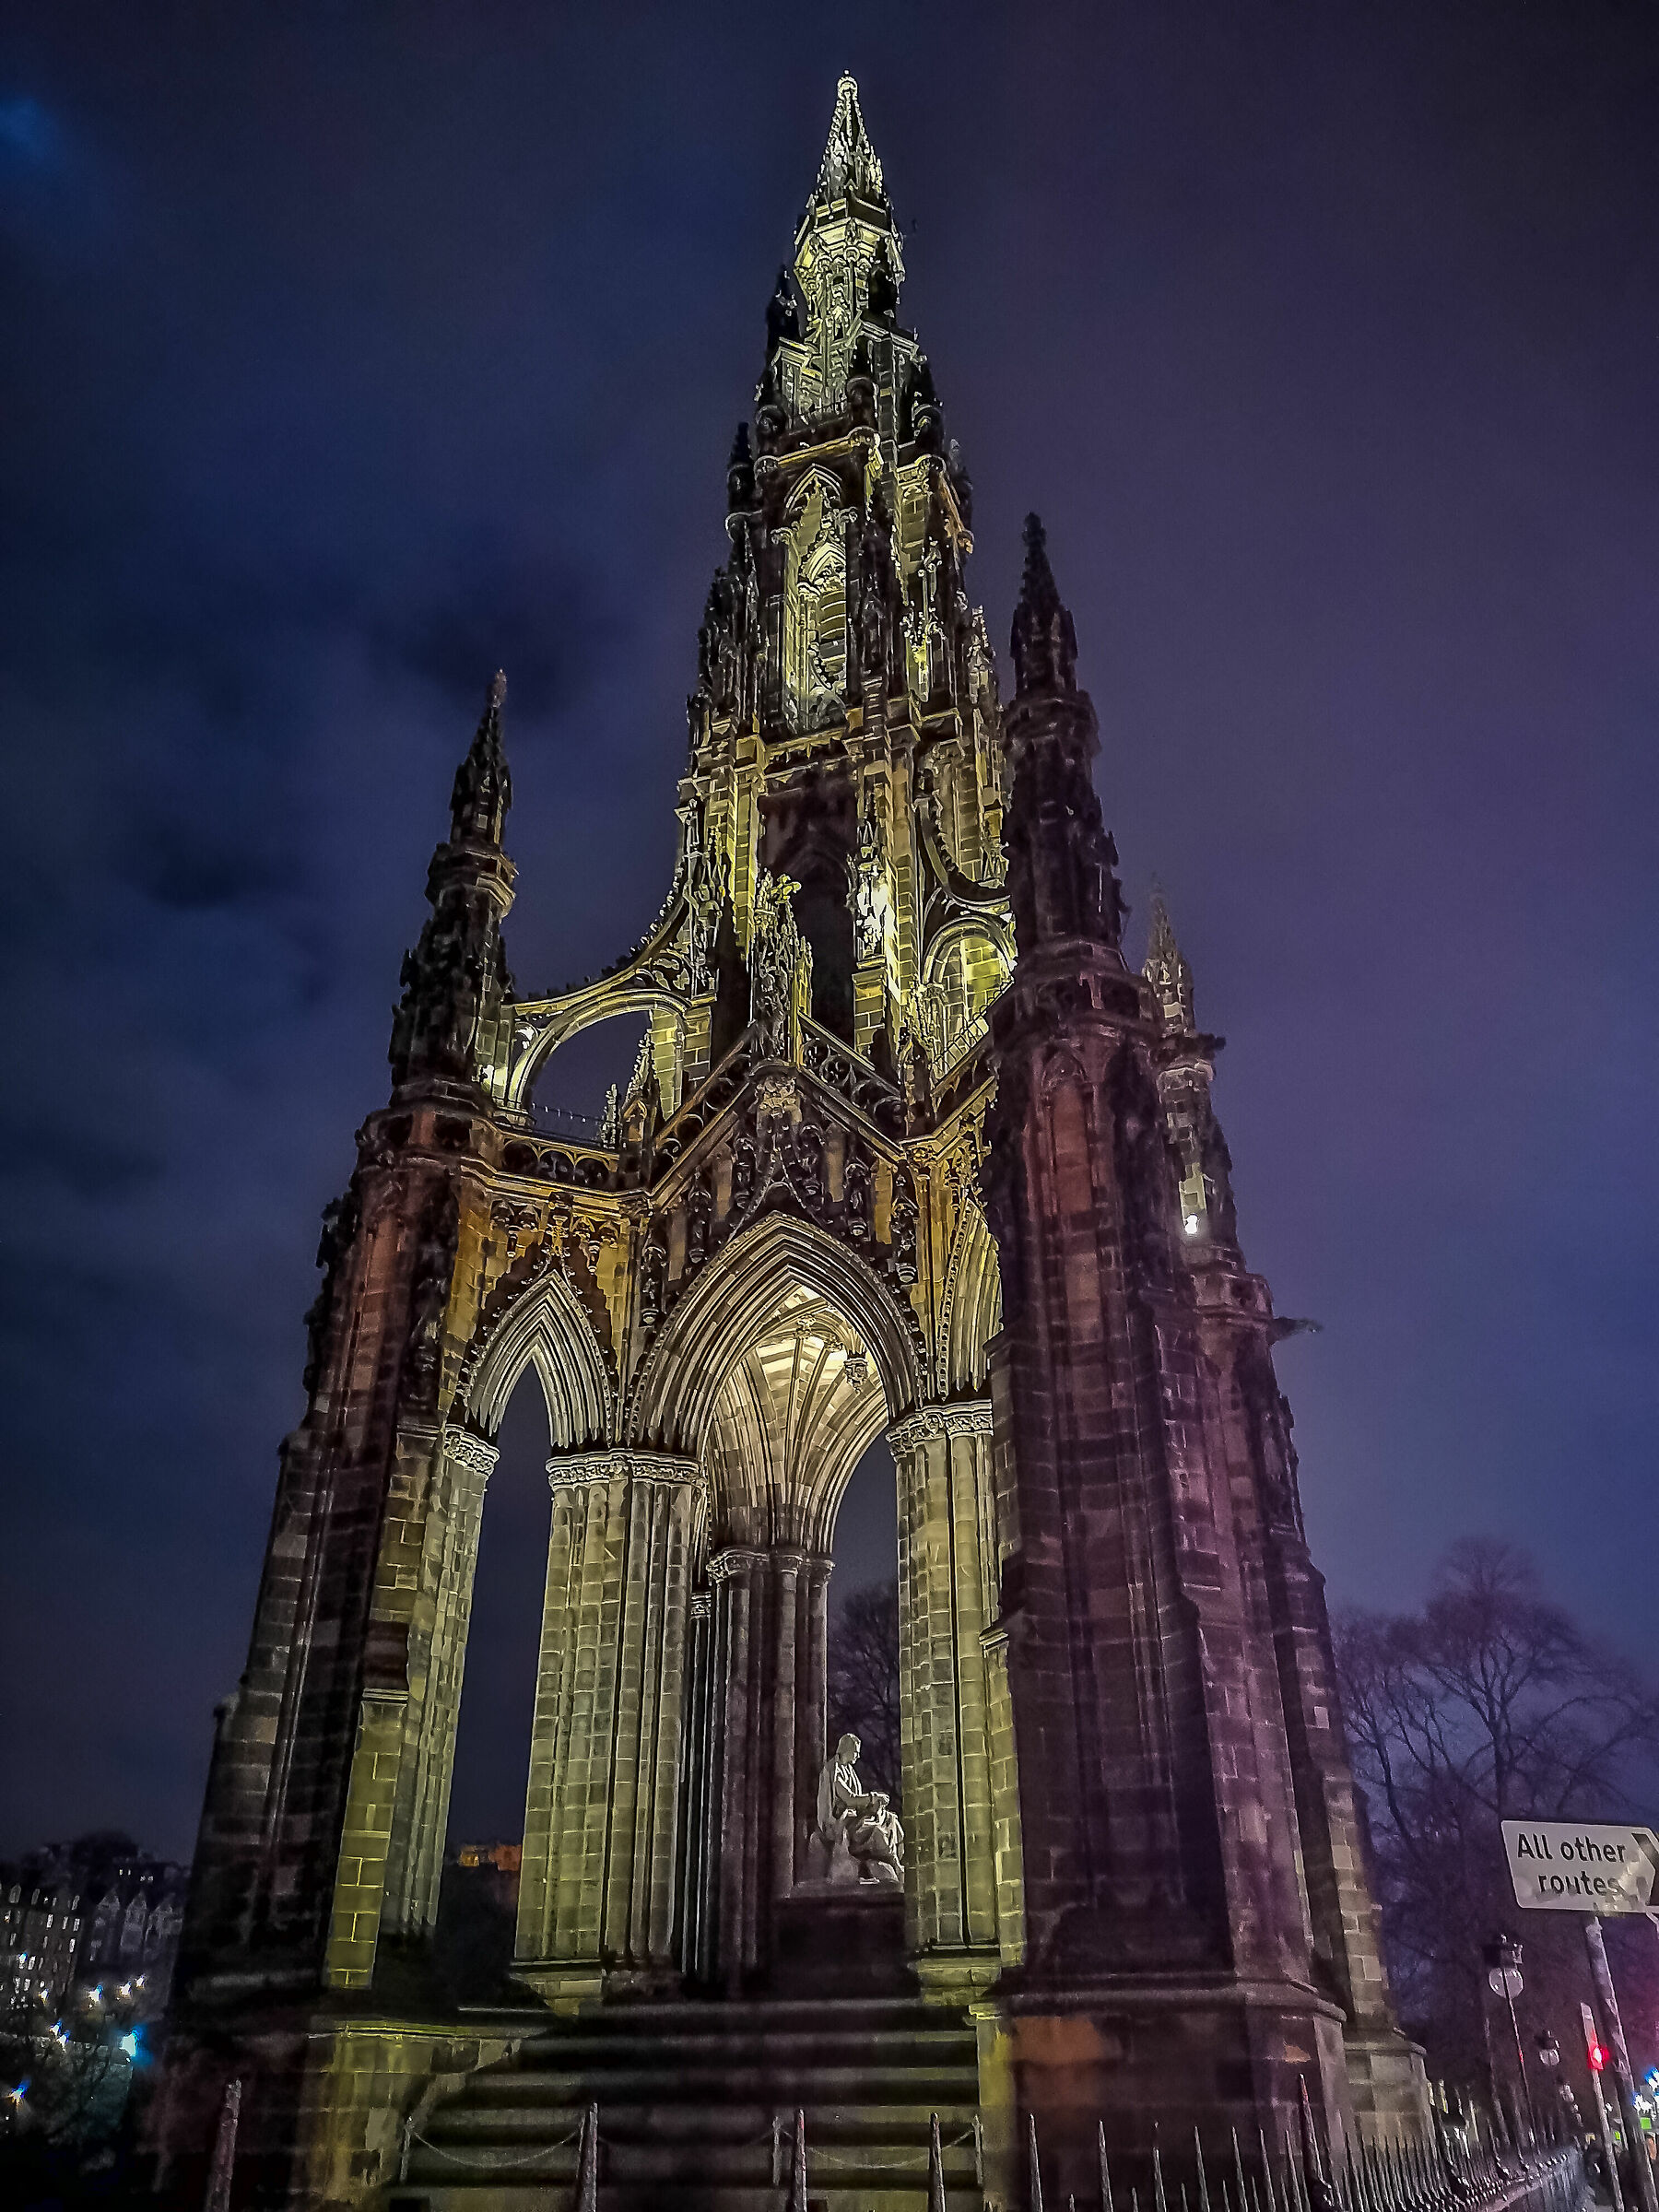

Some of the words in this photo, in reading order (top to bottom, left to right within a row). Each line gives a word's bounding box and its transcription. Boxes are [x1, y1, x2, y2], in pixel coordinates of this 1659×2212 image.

[1518, 1833, 1553, 1860] All
[1560, 1836, 1627, 1863] other
[1537, 1870, 1621, 1896] routes
